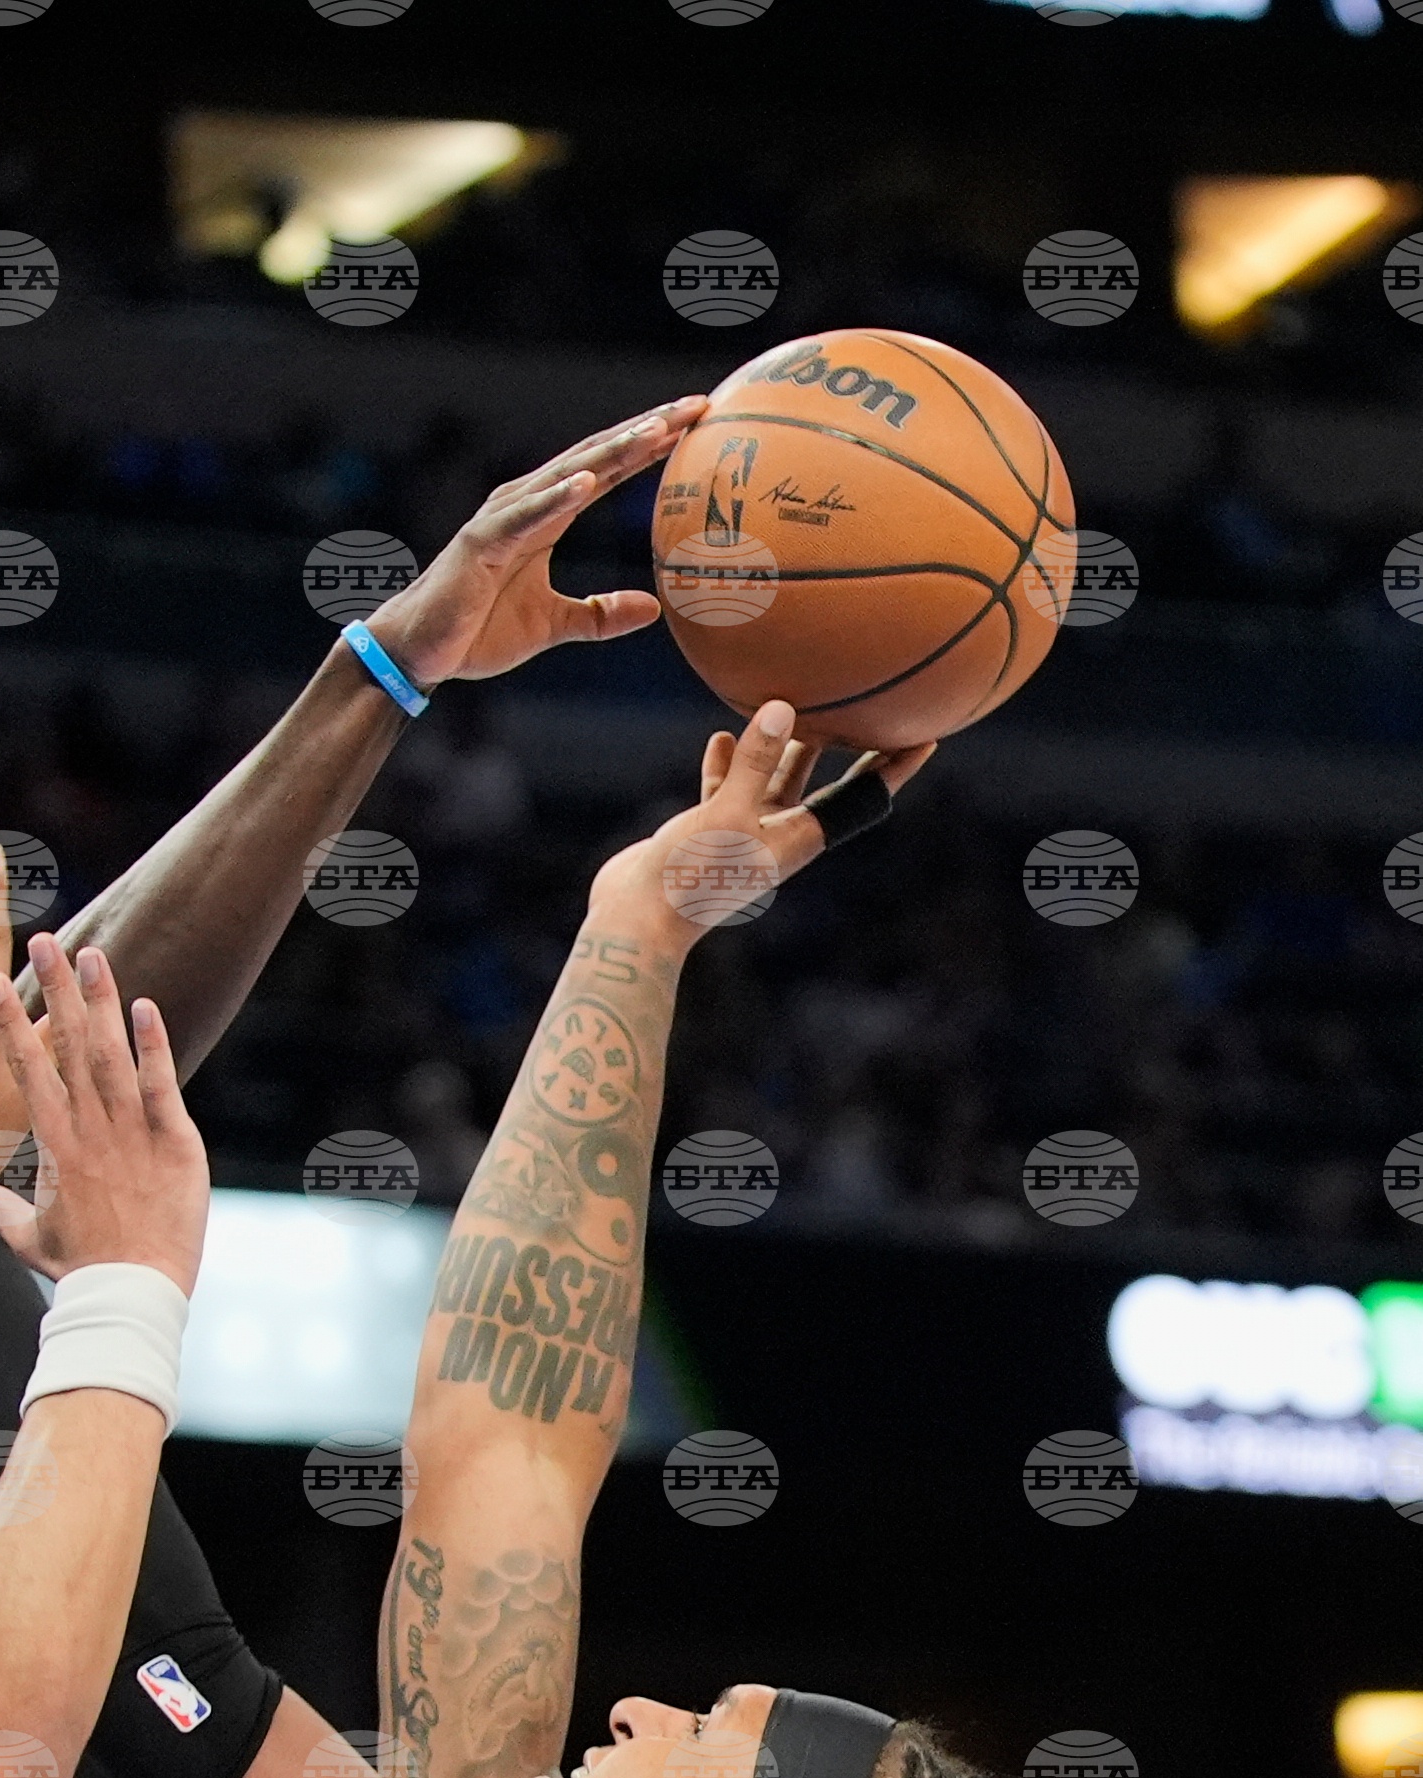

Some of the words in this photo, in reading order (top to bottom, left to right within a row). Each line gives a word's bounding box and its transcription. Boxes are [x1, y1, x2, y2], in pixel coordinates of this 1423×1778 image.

[746, 343, 919, 431] lson
[432, 1235, 635, 1362] RESSUR
[438, 1318, 615, 1424] KNOW
